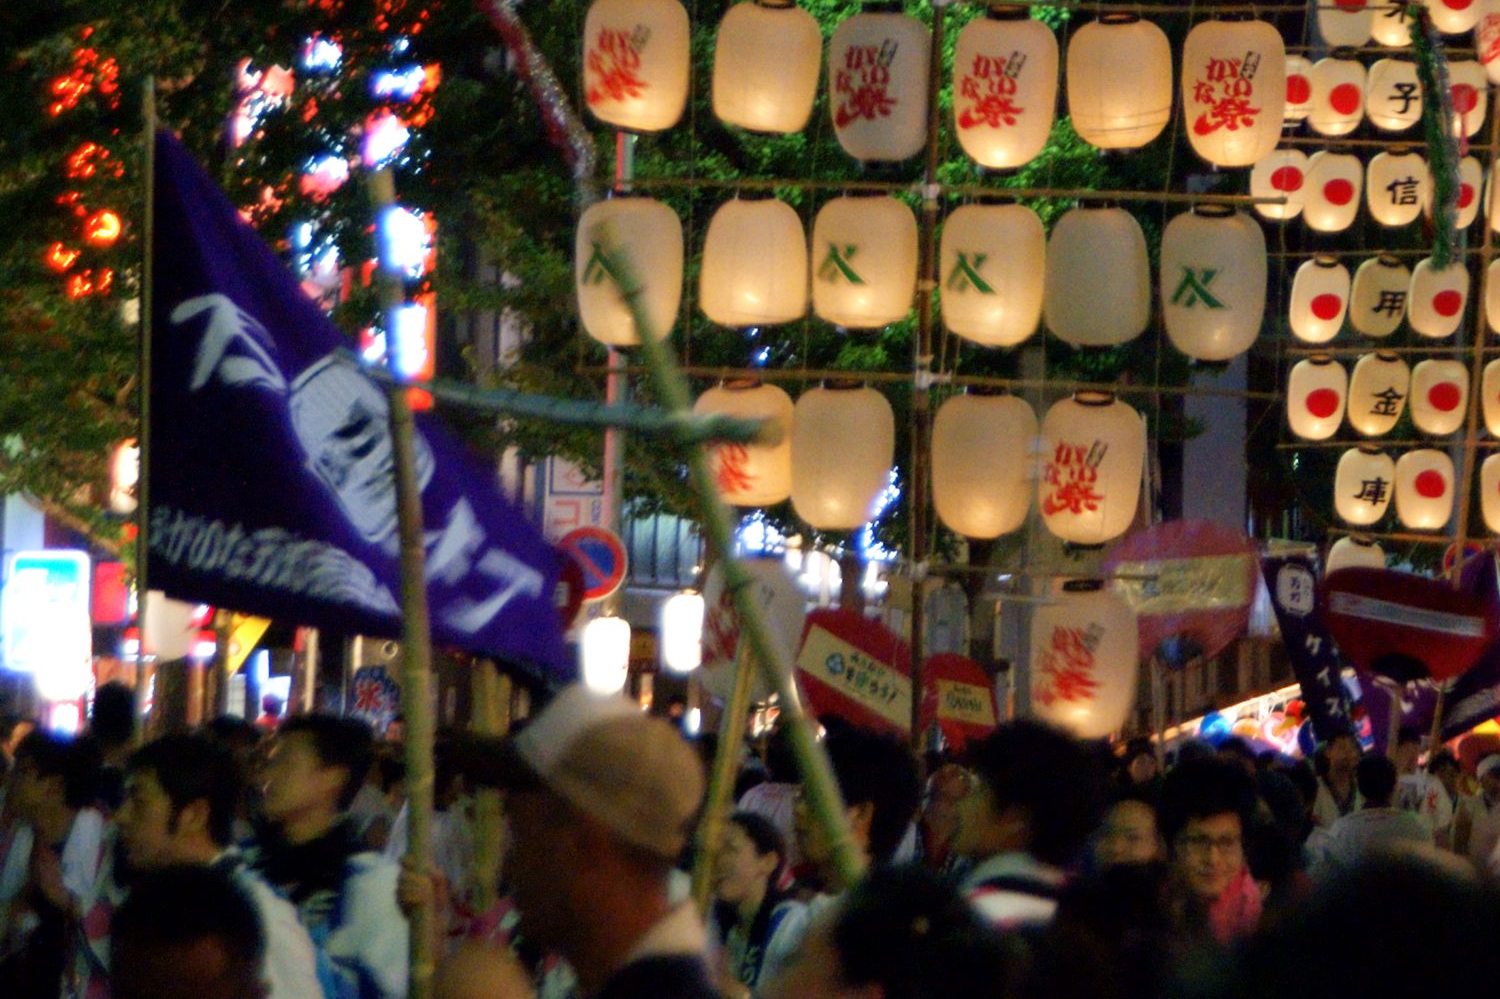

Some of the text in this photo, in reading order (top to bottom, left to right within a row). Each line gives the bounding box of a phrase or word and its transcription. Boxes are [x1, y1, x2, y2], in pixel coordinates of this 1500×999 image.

[1389, 82, 1419, 114] 子
[1387, 176, 1420, 206] 信
[1370, 385, 1404, 417] 金
[1353, 476, 1389, 507] 庫
